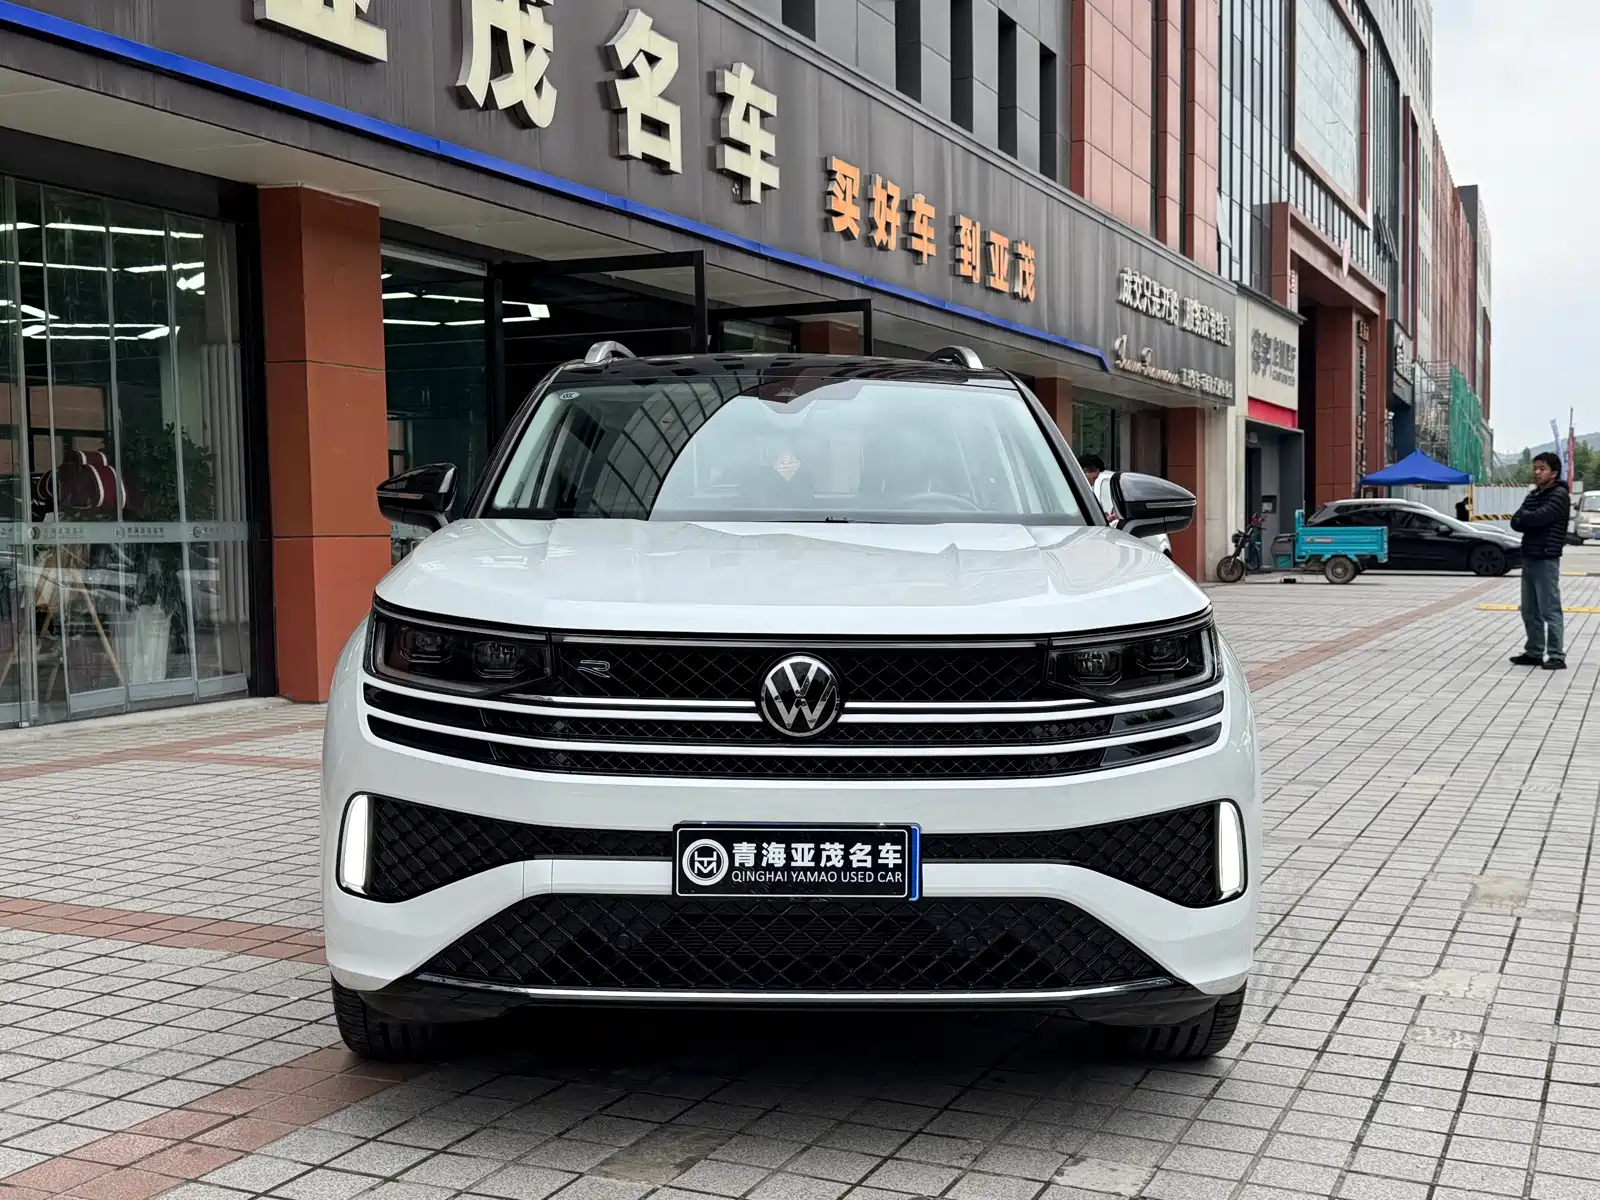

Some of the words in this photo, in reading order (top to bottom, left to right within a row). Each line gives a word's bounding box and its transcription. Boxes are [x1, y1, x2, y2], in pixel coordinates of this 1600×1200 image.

[825, 156, 936, 265] 买好车
[954, 213, 1036, 302] 到亚茂
[1119, 267, 1180, 325] 成交只是开始
[732, 841, 903, 868] 青海亚茂名车
[731, 870, 788, 883] QINGHAI
[790, 871, 837, 883] YAMAO
[841, 871, 874, 883] USED
[877, 871, 903, 883] CAR
